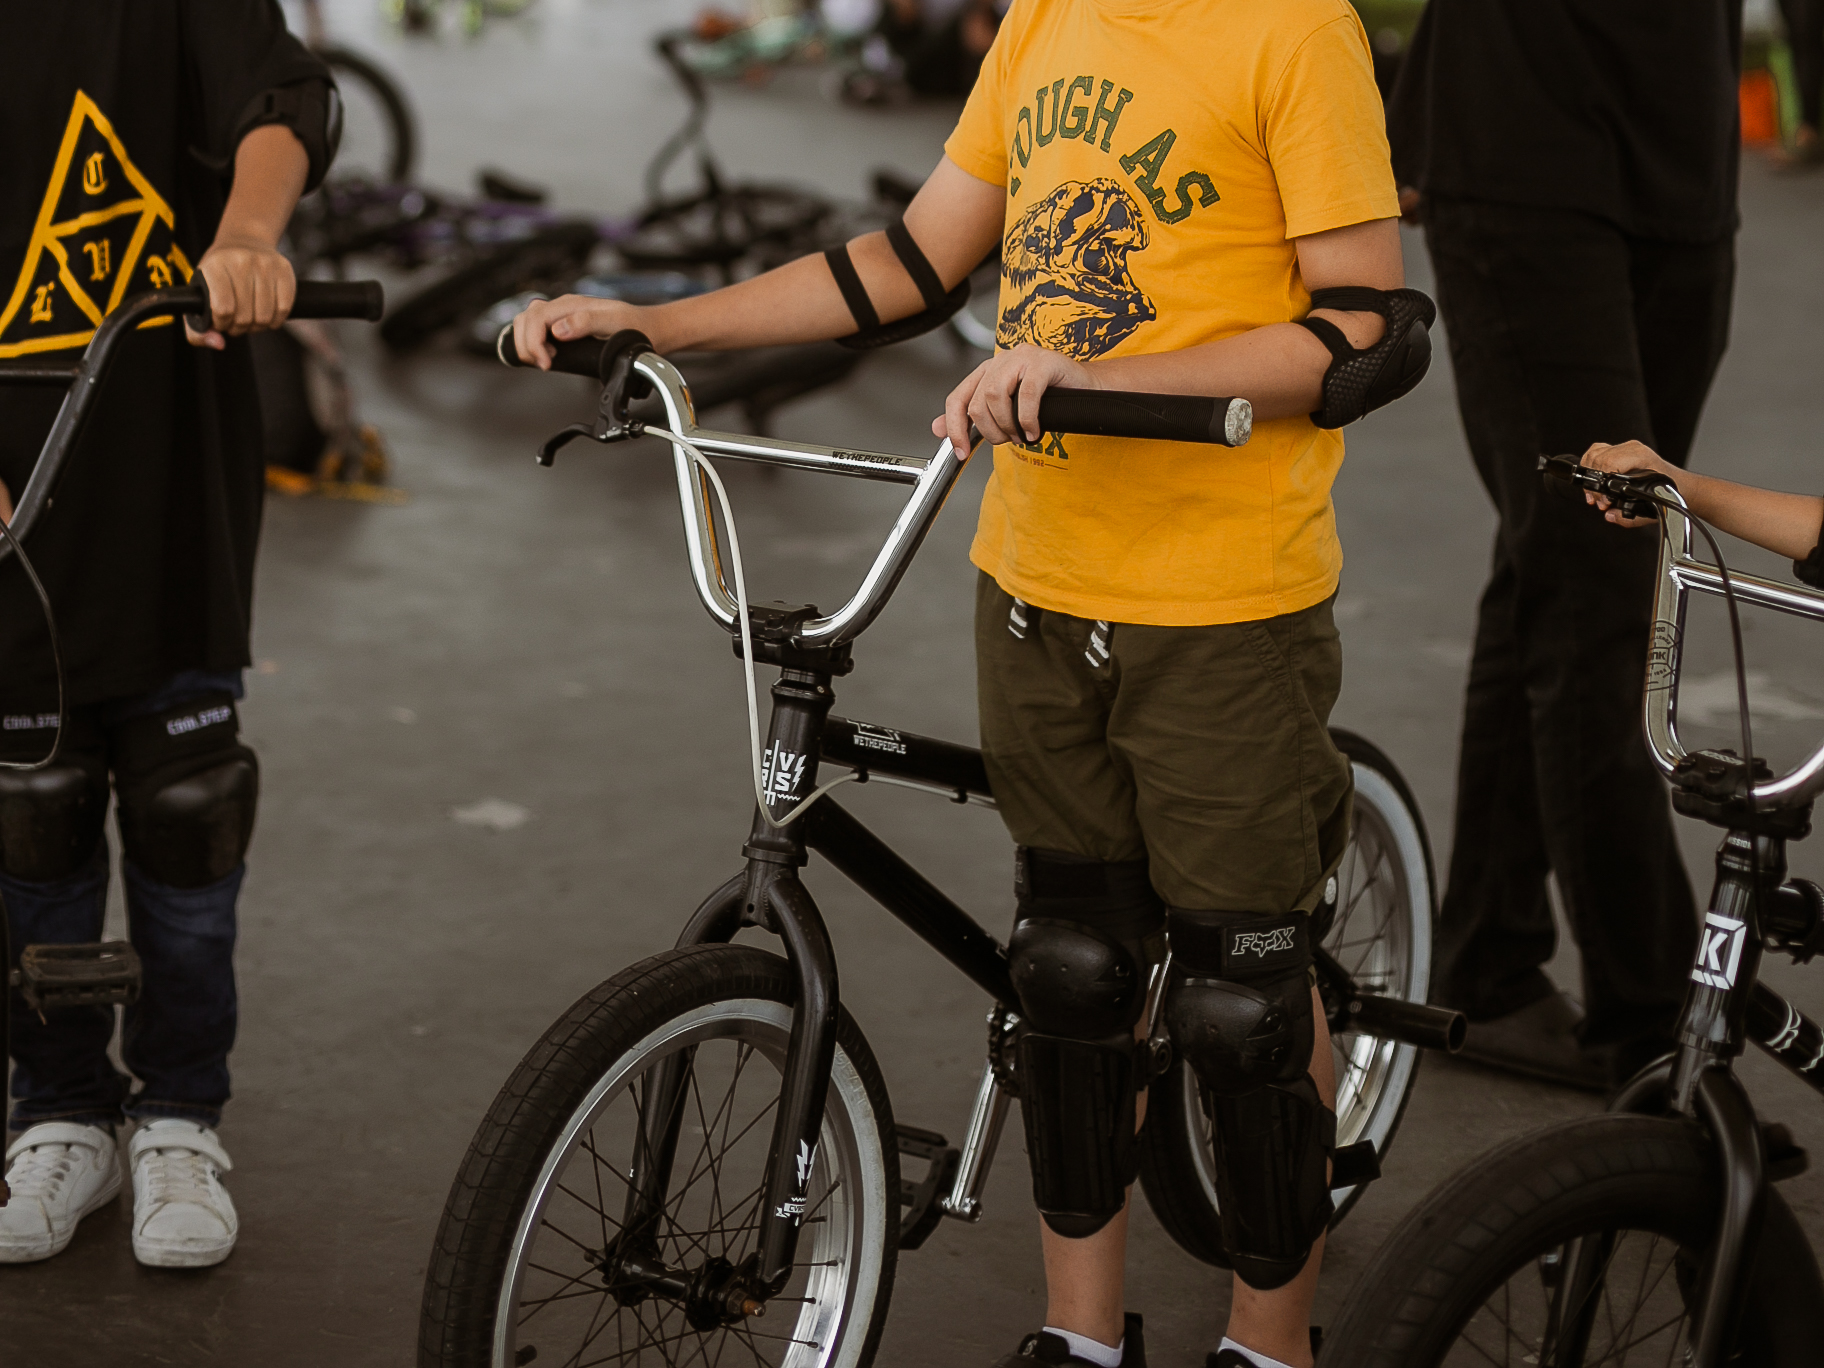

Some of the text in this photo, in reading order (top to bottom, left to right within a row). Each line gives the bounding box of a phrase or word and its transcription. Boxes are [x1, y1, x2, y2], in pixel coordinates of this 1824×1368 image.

[1010, 75, 1221, 225] OUGH AS
[832, 450, 903, 466] WETHEPEOPLE
[853, 734, 907, 755] WETHEPEOPLE
[1231, 926, 1296, 958] FOX
